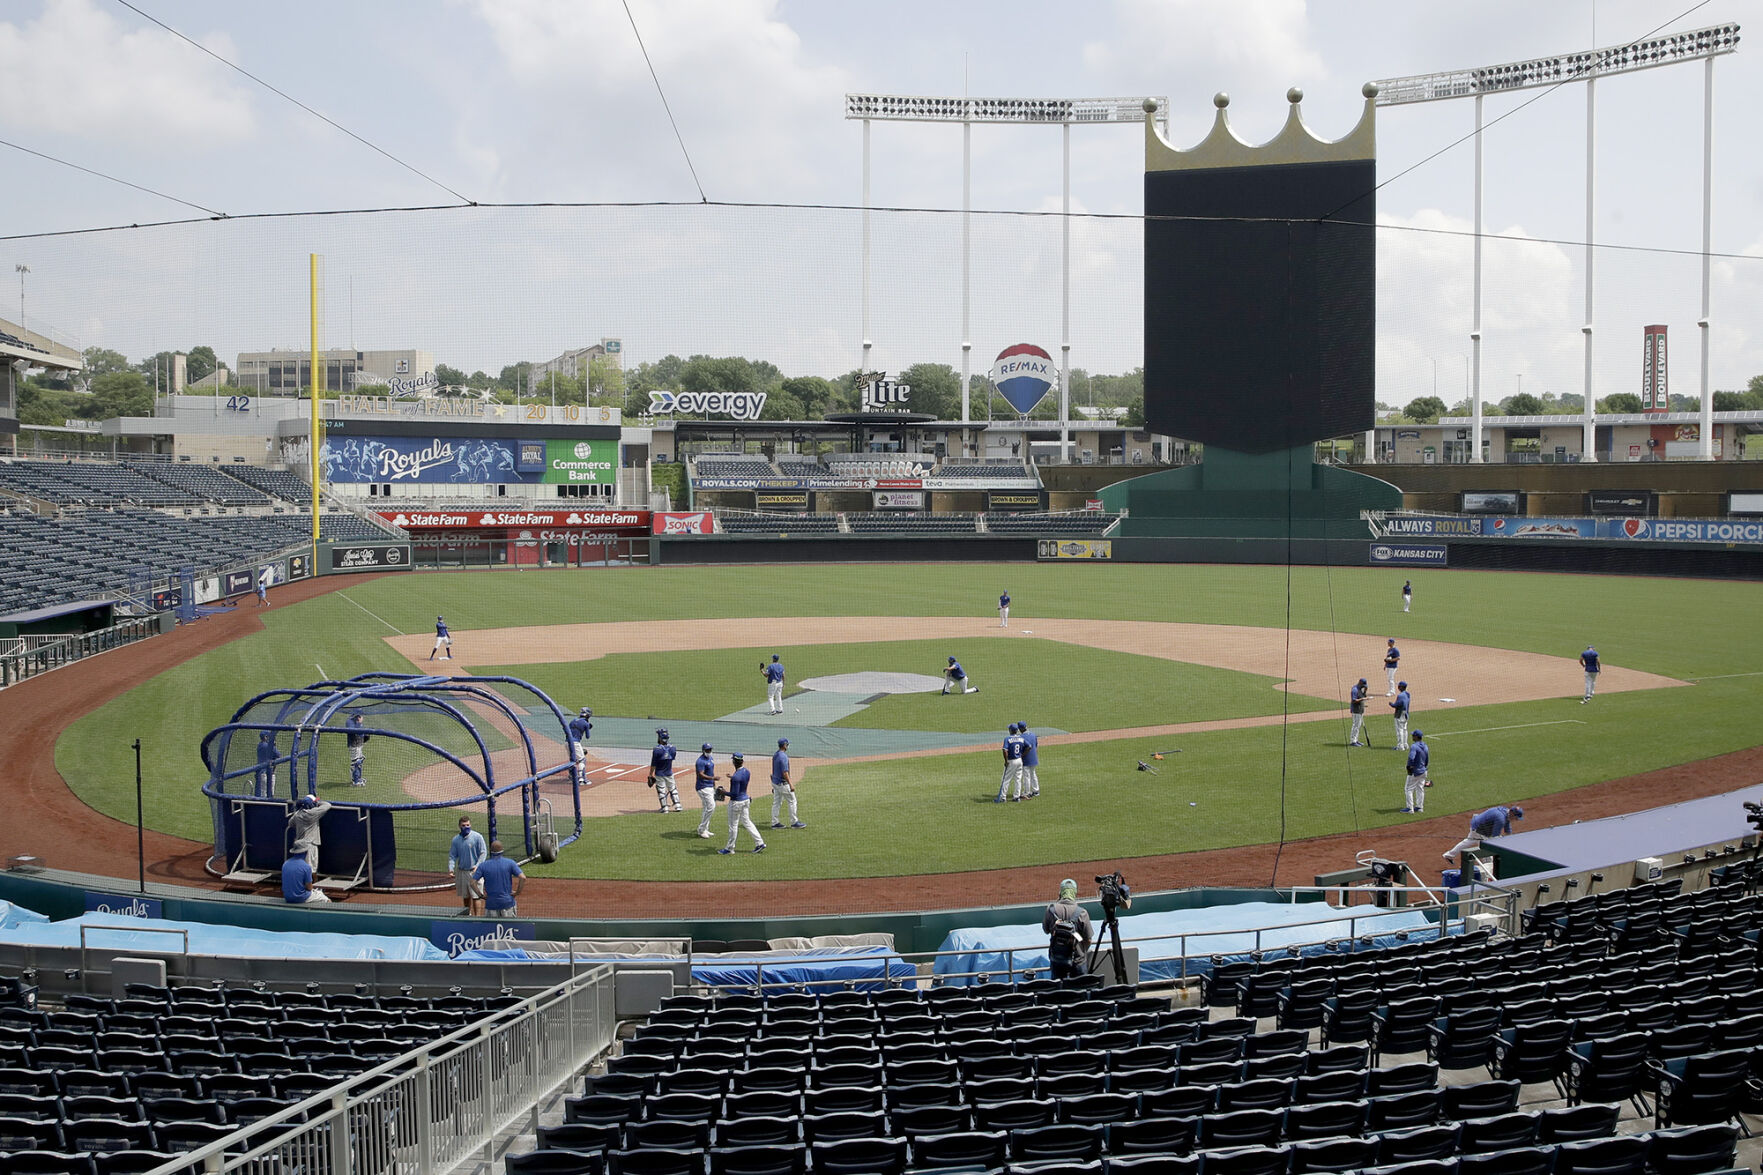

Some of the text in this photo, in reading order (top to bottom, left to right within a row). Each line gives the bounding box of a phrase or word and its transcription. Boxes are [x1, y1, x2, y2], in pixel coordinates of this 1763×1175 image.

[1001, 361, 1048, 375] RE/MAX
[1644, 340, 1652, 402] BOULEVARD
[1658, 340, 1666, 402] BOULEVARD
[389, 371, 439, 397] Royals
[866, 379, 912, 408] Lite
[226, 396, 250, 411] 42
[340, 395, 400, 414] HALL
[423, 399, 485, 416] FAME
[678, 393, 765, 418] evergy
[526, 404, 610, 421] 20 10 5
[378, 438, 455, 480] Royals
[553, 460, 612, 470] Commerce
[568, 470, 597, 481] Bank
[702, 478, 798, 488] ROYALS.COM/THEKEEP
[809, 480, 863, 489] PrimeLending
[890, 494, 914, 503] planet
[667, 520, 699, 530] SONIC
[1388, 520, 1471, 533] ALWAYS ROYAL
[1655, 523, 1702, 538] PEPSI
[1393, 549, 1426, 558] KANSAS
[1426, 550, 1445, 558] CITY
[1014, 743, 1020, 754] 8
